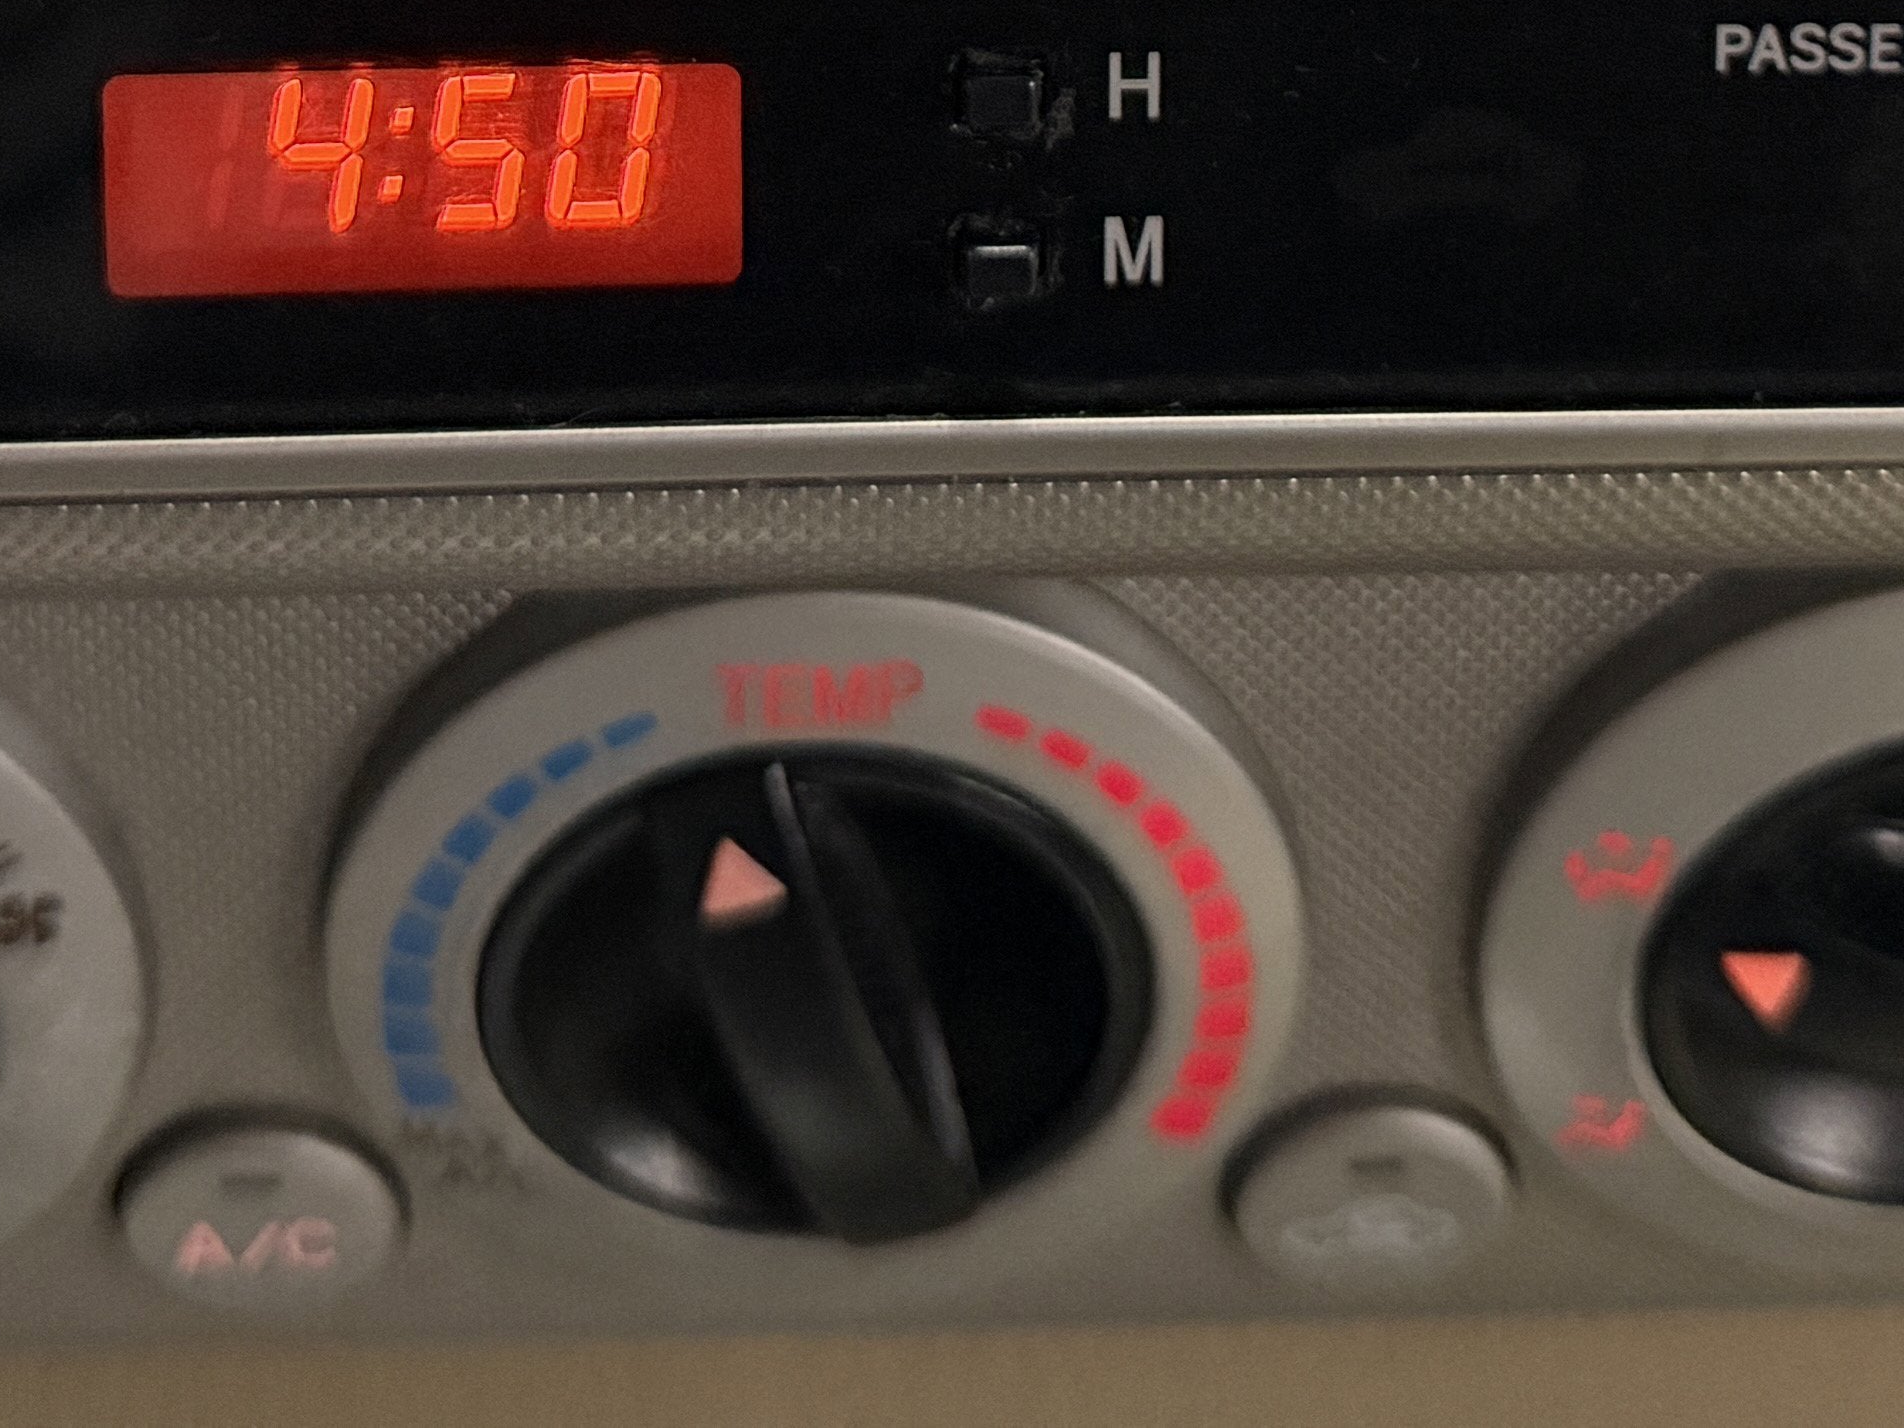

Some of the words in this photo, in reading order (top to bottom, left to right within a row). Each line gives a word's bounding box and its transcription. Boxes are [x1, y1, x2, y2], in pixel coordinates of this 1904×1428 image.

[1107, 51, 1162, 120] H
[270, 71, 662, 232] 4:50
[1102, 215, 1164, 285] M
[715, 659, 925, 731] TEMP
[174, 1217, 339, 1275] A/C
